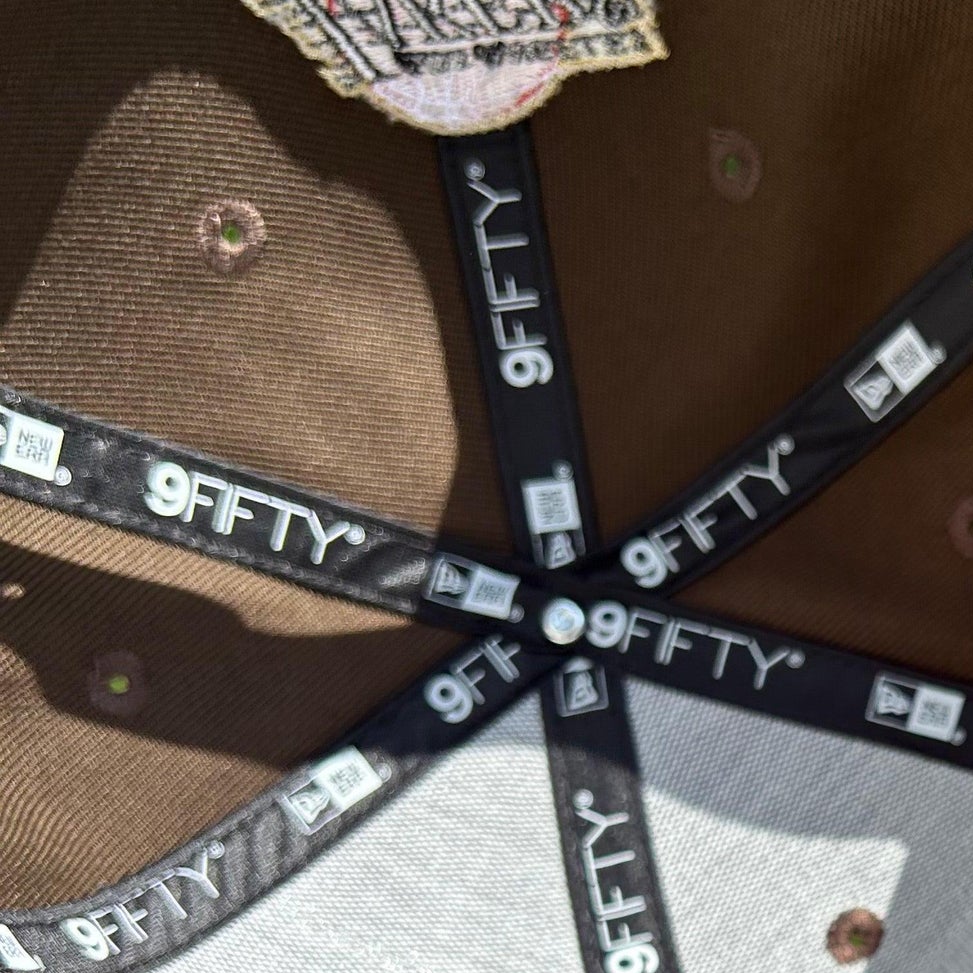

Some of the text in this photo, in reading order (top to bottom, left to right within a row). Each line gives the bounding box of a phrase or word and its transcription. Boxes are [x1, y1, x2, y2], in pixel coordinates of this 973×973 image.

[466, 176, 554, 389] 9FIFTY
[143, 461, 352, 566] 9FIFTY
[620, 441, 792, 589] 9FIFTY
[585, 600, 790, 690] 9FIFTY
[62, 850, 221, 961] 9FIFTY
